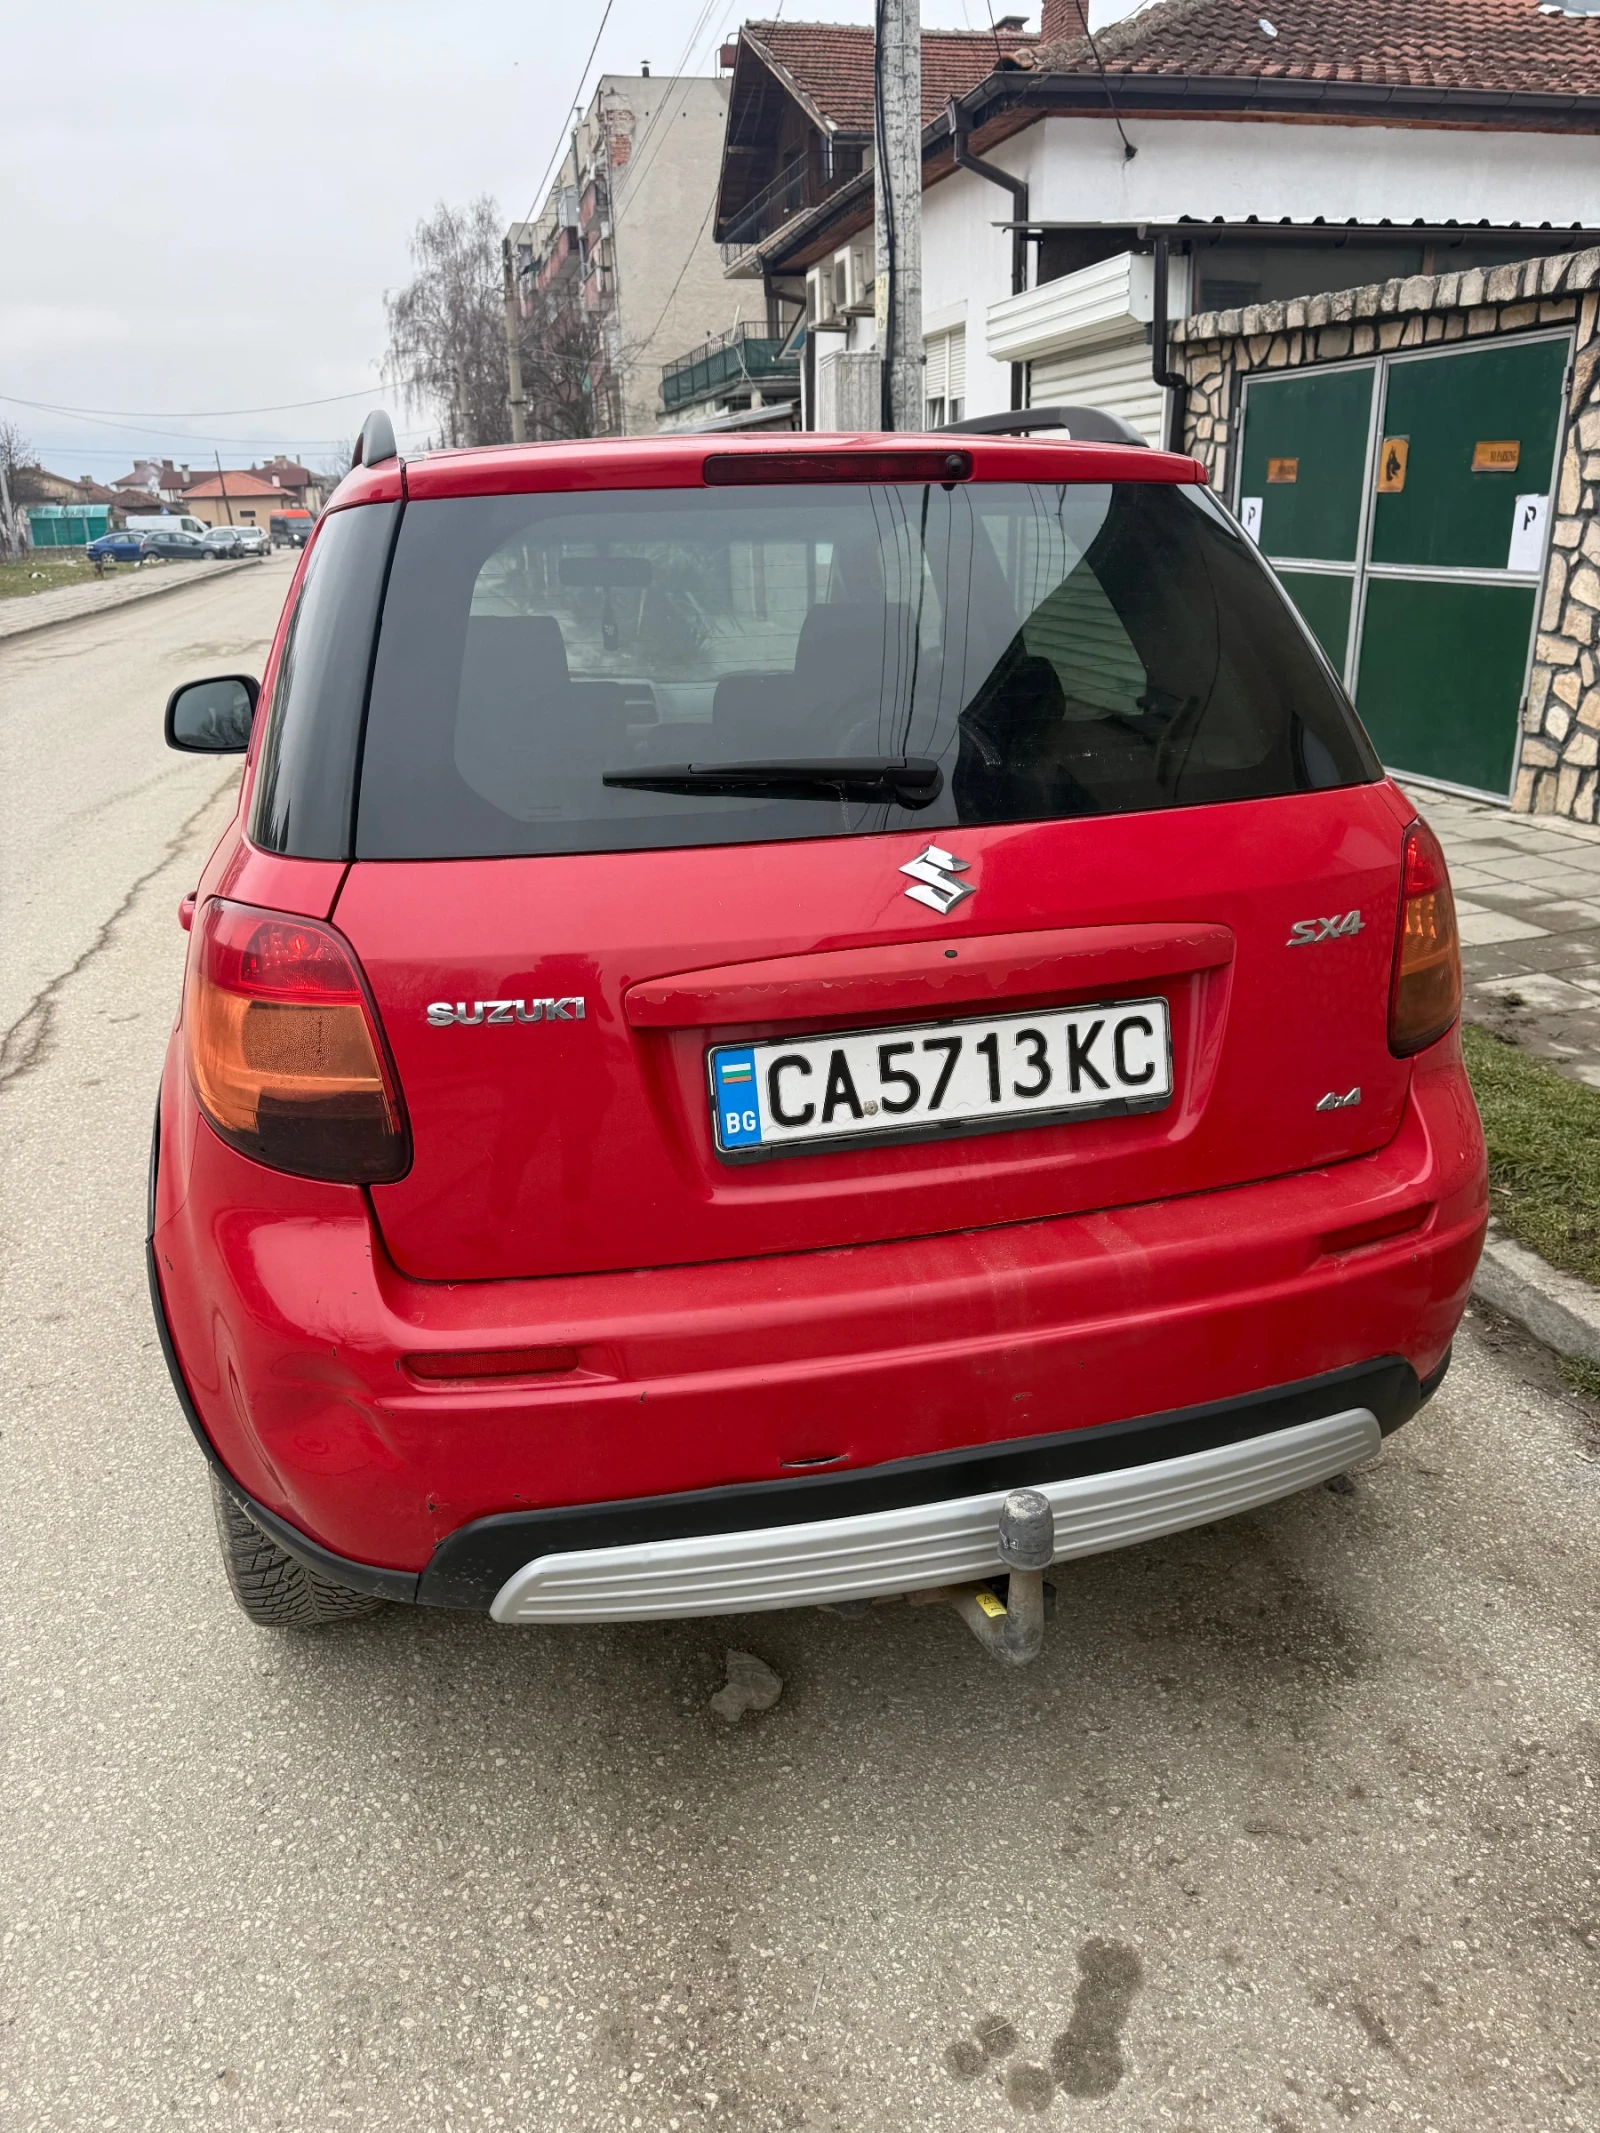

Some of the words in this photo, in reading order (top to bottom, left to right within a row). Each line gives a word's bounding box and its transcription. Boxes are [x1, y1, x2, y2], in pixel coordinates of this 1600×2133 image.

[1523, 505, 1537, 531] P
[1286, 910, 1367, 947] SX4
[427, 996, 586, 1026] SUZUKI
[1315, 1087, 1362, 1112] 4x4
[726, 1111, 757, 1135] BG
